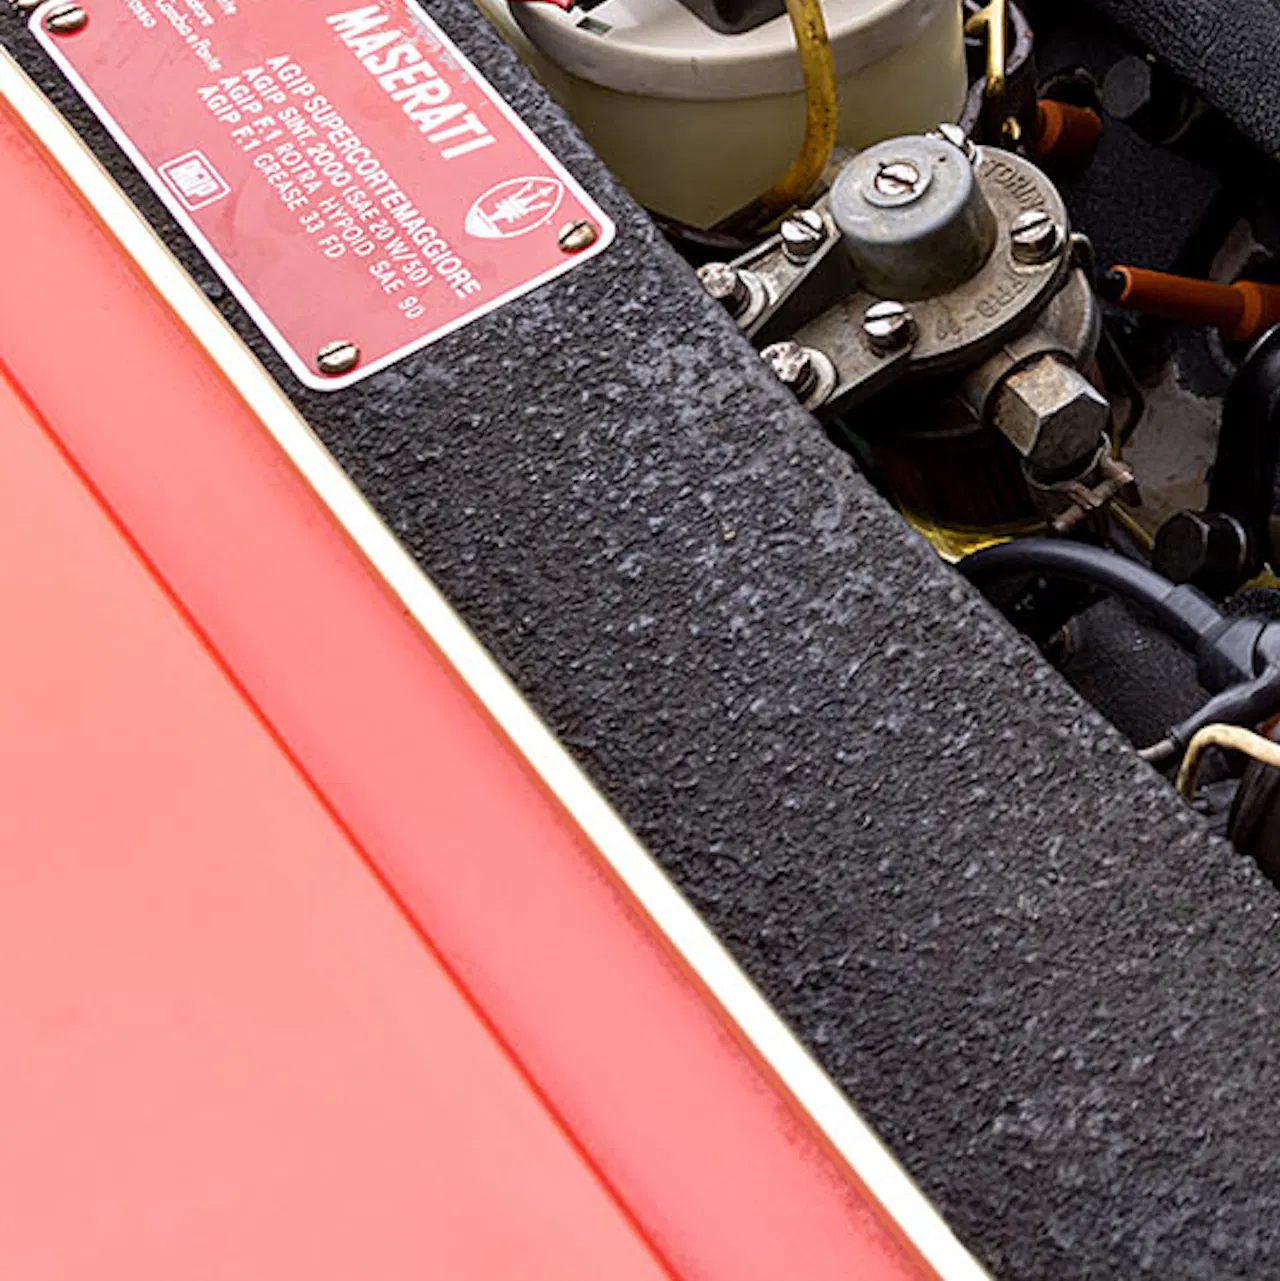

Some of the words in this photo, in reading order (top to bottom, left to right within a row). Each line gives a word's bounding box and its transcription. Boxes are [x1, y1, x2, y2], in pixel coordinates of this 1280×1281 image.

[242, 67, 286, 104] AGIP
[307, 142, 352, 188] 2000
[342, 179, 380, 221] (SAE
[369, 219, 395, 241] 20
[327, 4, 496, 159] MASERATI
[197, 85, 241, 125] AGIP
[254, 153, 309, 211] GREASE
[300, 211, 325, 233] 33
[318, 234, 346, 259] FD
[219, 76, 263, 114] AGIP
[275, 142, 323, 195] ROTRA
[318, 196, 375, 257] HYPOID
[369, 260, 405, 294] SAE
[399, 296, 424, 319] 90
[266, 55, 315, 98] AGIP
[304, 94, 481, 299] SUPERCORTEMAGGIORE
[982, 161, 1046, 212] TORIN
